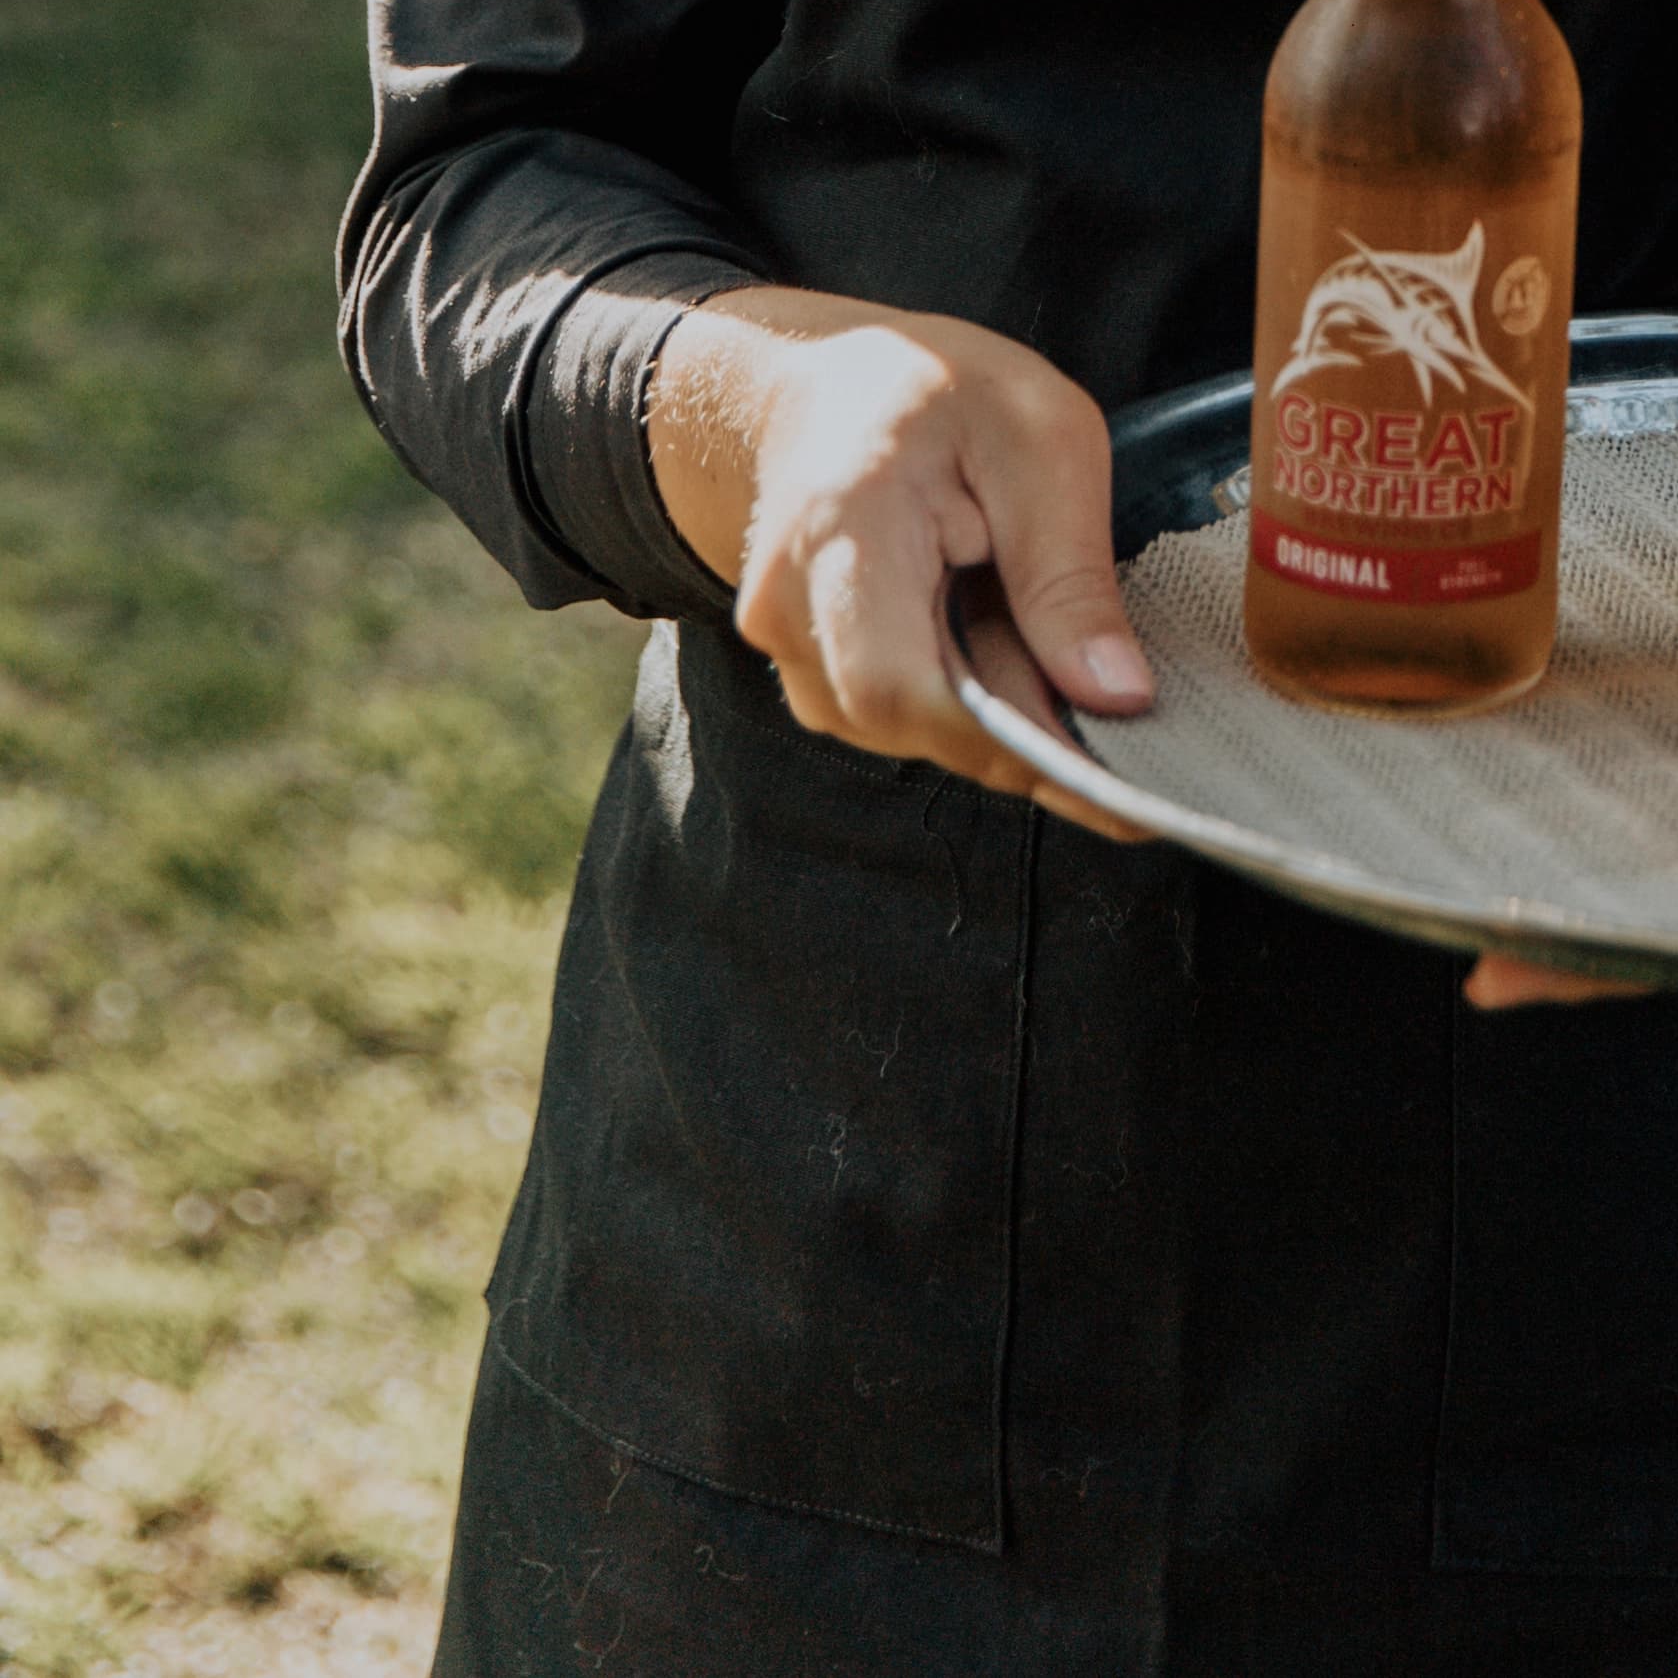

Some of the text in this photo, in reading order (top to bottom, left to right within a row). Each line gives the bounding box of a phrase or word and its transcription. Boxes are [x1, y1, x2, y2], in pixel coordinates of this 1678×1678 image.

[1276, 391, 1519, 474] GREAT
[1273, 453, 1517, 519] NORTHERN
[1275, 535, 1391, 592] ORIGINAL
